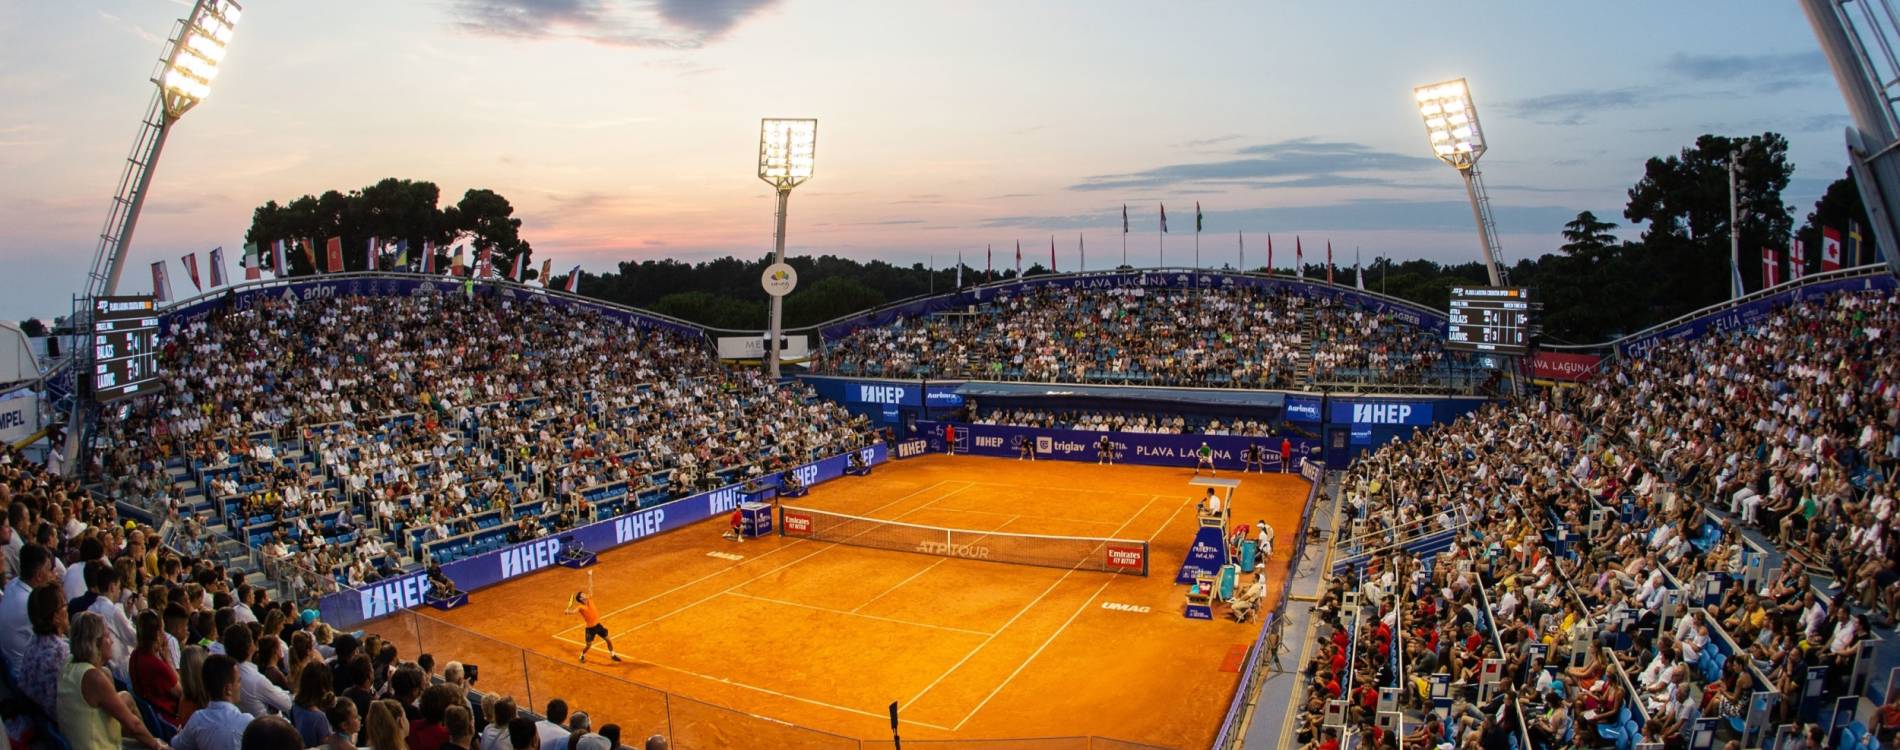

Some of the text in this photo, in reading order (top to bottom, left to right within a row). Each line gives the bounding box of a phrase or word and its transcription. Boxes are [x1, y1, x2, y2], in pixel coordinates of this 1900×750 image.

[1074, 275, 1112, 290] PLAVA
[303, 282, 336, 301] ador
[1493, 313, 1498, 323] 4
[1492, 331, 1497, 341] 3
[1517, 332, 1522, 343] 0
[1552, 361, 1591, 374] LAGUNA
[874, 386, 905, 404] HEP
[1373, 404, 1411, 424] HEP
[906, 440, 927, 456] HEP
[985, 436, 1004, 448] HEP
[1054, 440, 1085, 452] triglav
[1136, 446, 1174, 458] PLAVA
[1180, 447, 1232, 460] LANA
[634, 509, 665, 536] HEP
[522, 538, 560, 574] HEP
[1109, 549, 1141, 560] Emirates
[386, 574, 431, 612] HEP
[1102, 601, 1151, 613] UMAG
